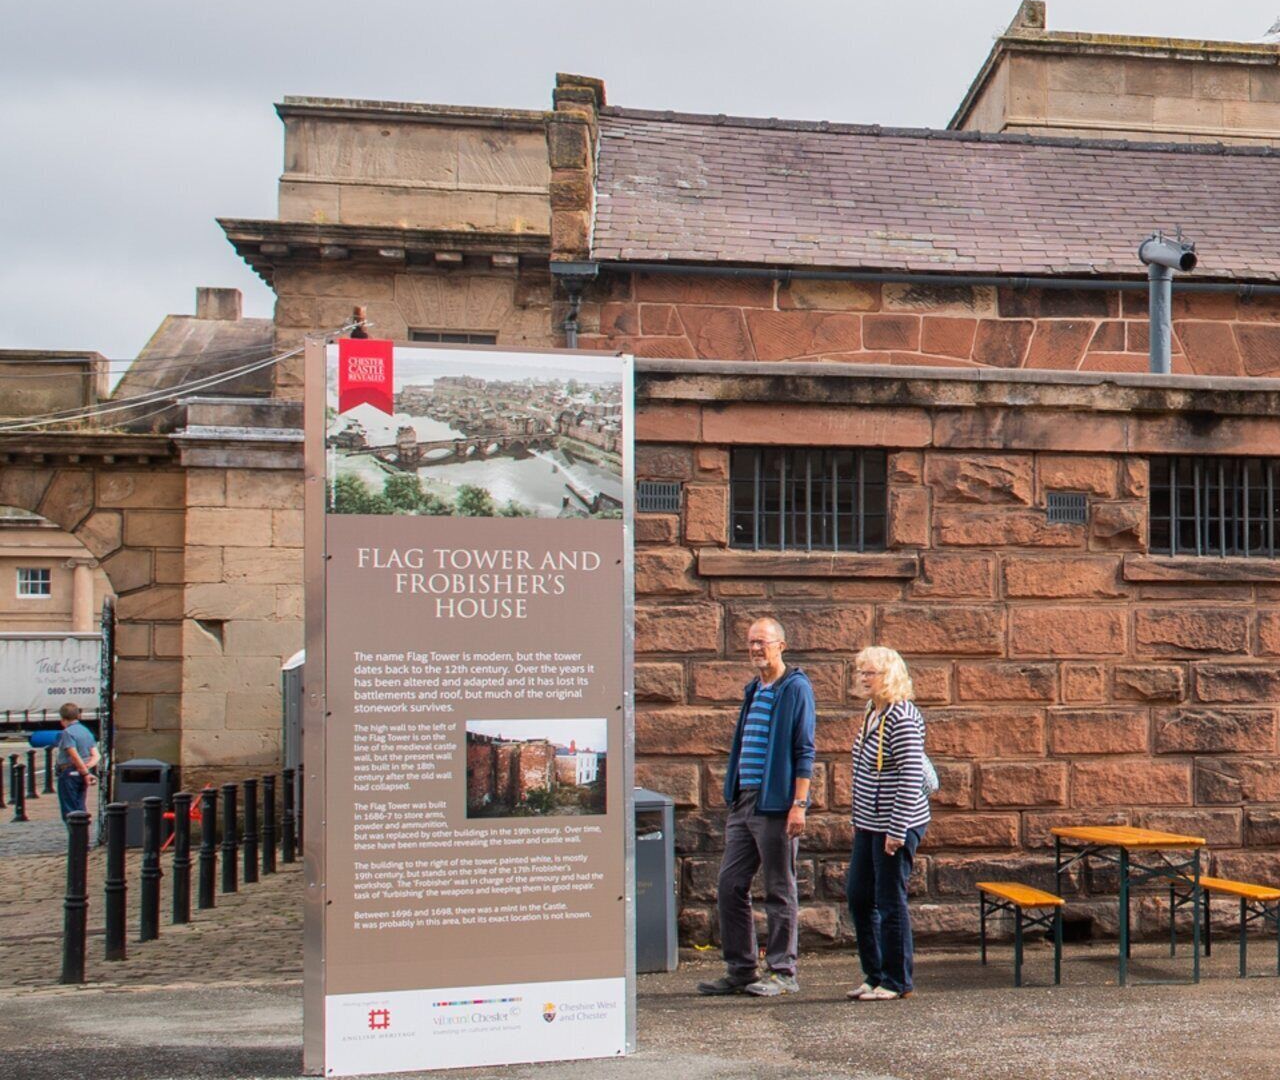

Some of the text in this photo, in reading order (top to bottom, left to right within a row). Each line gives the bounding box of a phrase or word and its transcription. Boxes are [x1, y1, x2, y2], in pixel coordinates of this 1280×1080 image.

[349, 358, 383, 366] CHESTER
[349, 366, 384, 374] CASTLE
[357, 548, 601, 571] FLAG TOWER AND
[395, 573, 566, 595] FROBISHER'S
[435, 598, 528, 619] HOUSE
[354, 651, 581, 664] The name Flag Tower is modern, but the tower
[354, 664, 594, 676] dates back to the 12th century. Over the years it
[354, 677, 589, 688] has been altered and adapted and it has lost its
[354, 689, 582, 701] battlements and roof, but much of the original
[354, 703, 454, 713] stonework survives.
[354, 723, 456, 734] The high wall to the left of
[369, 734, 386, 743] Flag
[432, 733, 446, 741] the
[396, 743, 432, 751] medieval
[434, 743, 457, 751] castle
[389, 753, 402, 761] the
[404, 753, 434, 762] present
[354, 773, 384, 783] century
[420, 772, 434, 780] old
[354, 802, 368, 810] The
[369, 802, 386, 811] Flag
[428, 801, 447, 809] built
[354, 823, 382, 832] powder
[386, 831, 419, 841] replaced
[420, 831, 430, 840] by
[431, 830, 452, 838] other
[453, 829, 489, 839] buildings
[499, 828, 512, 836] the
[564, 826, 582, 834] Over
[354, 910, 389, 919] Between
[414, 908, 429, 916] and
[455, 906, 475, 915] there
[500, 904, 518, 913] mint
[519, 904, 527, 912] in
[528, 903, 541, 912] the
[354, 921, 360, 929] It
[378, 919, 415, 930] probably
[425, 918, 440, 926] this
[477, 916, 487, 924] its
[488, 915, 509, 923] exact
[510, 914, 541, 922] location
[550, 913, 564, 921] not
